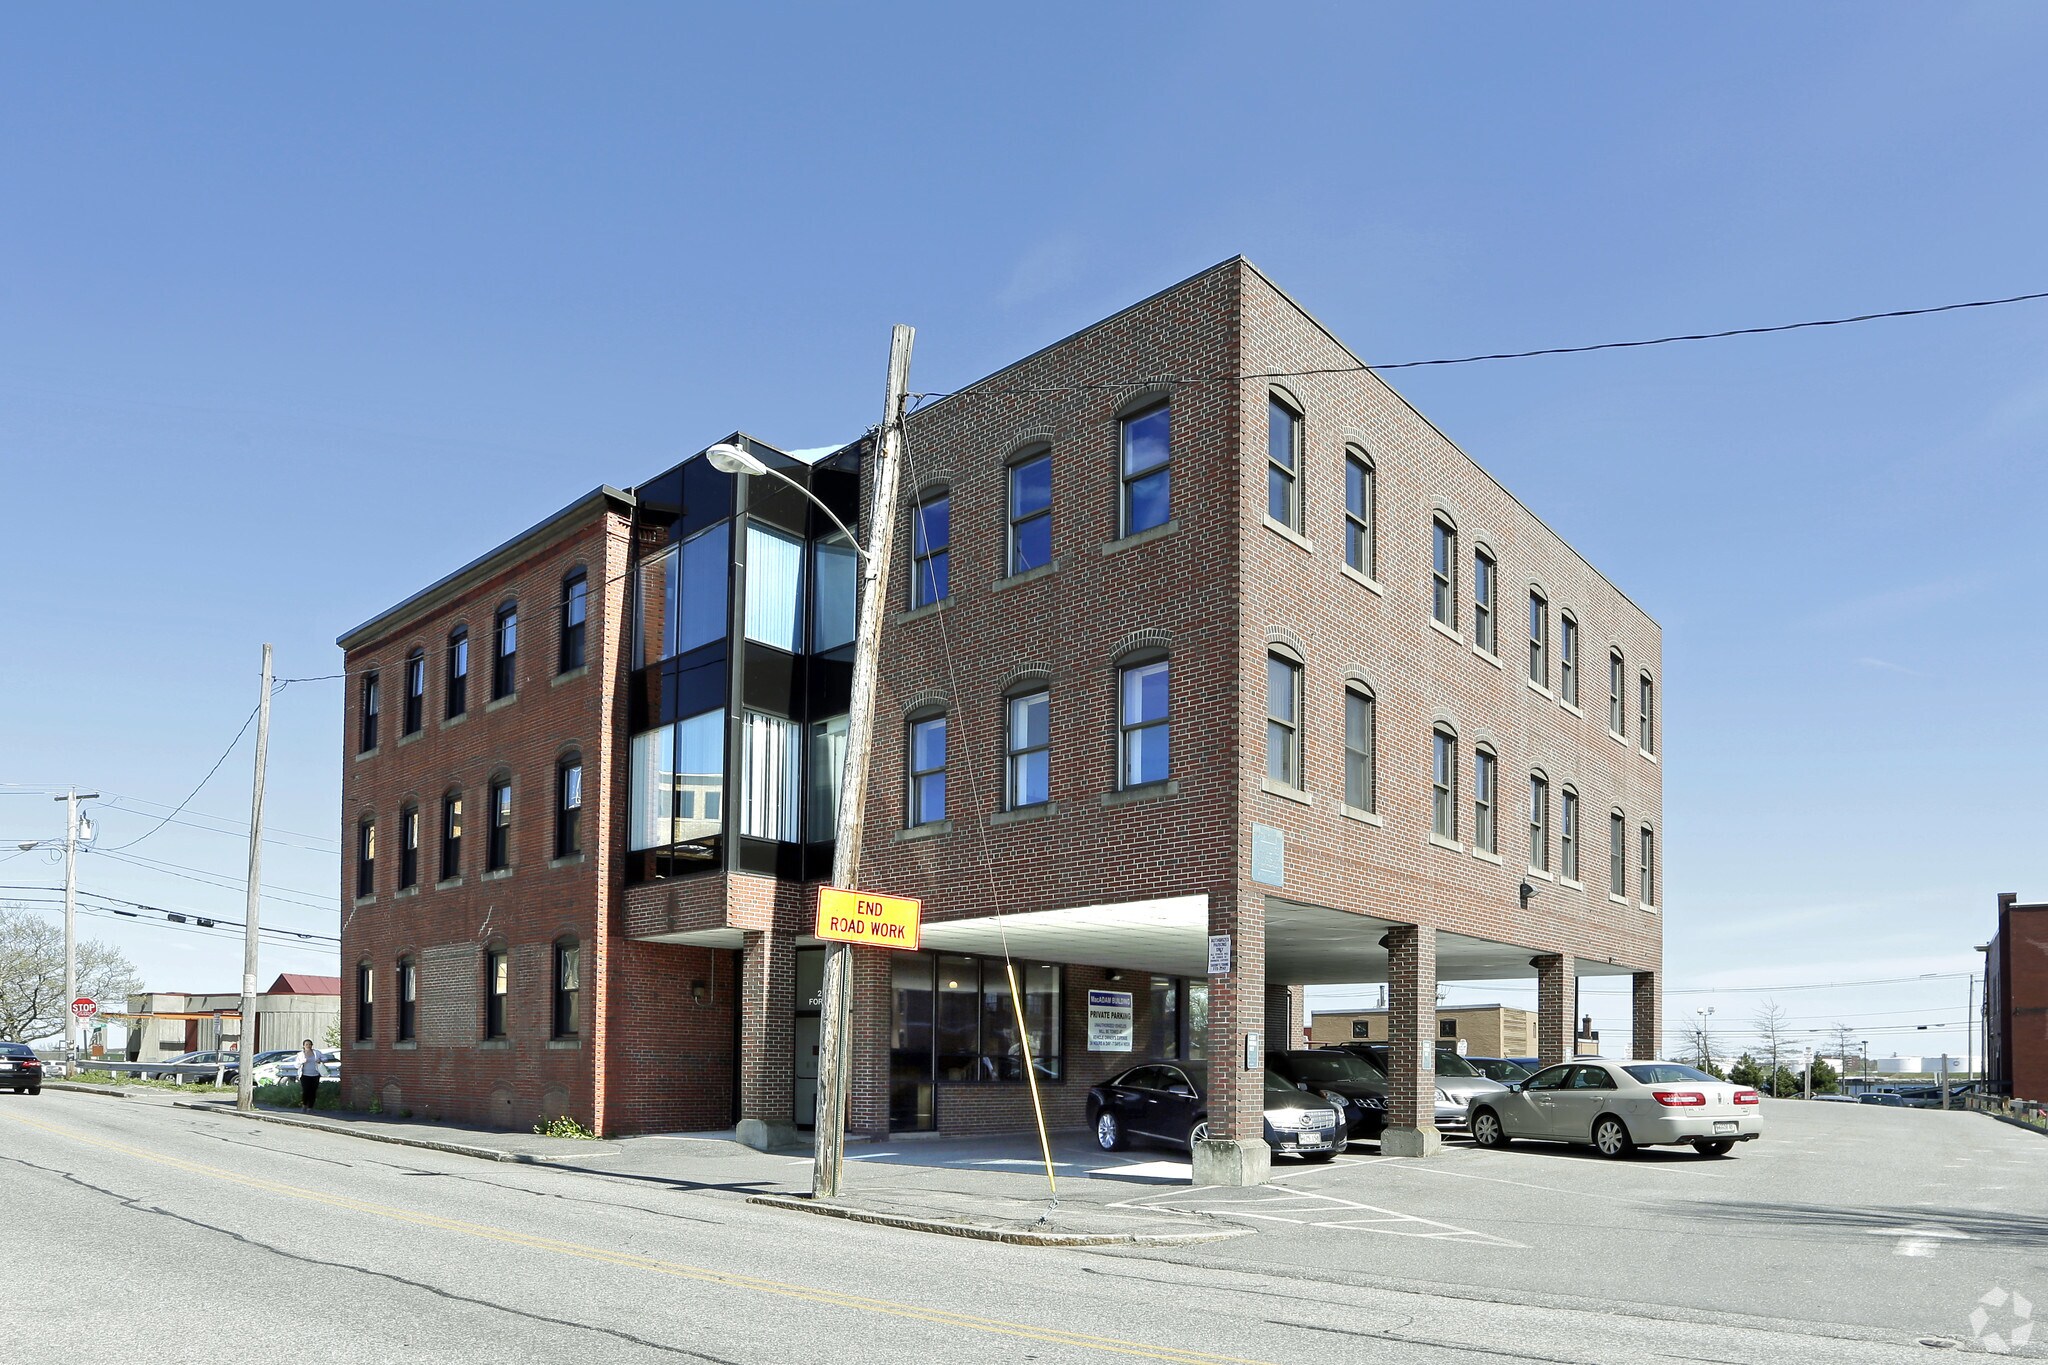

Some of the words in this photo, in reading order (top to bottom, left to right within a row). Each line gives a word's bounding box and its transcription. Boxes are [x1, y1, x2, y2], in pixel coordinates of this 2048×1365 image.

[858, 900, 883, 917] END
[830, 916, 865, 934] ROAD
[871, 921, 906, 939] WORK
[72, 1004, 95, 1012] STOP
[1090, 1010, 1110, 1019] PRIVATE
[1111, 1011, 1131, 1020] PARKING
